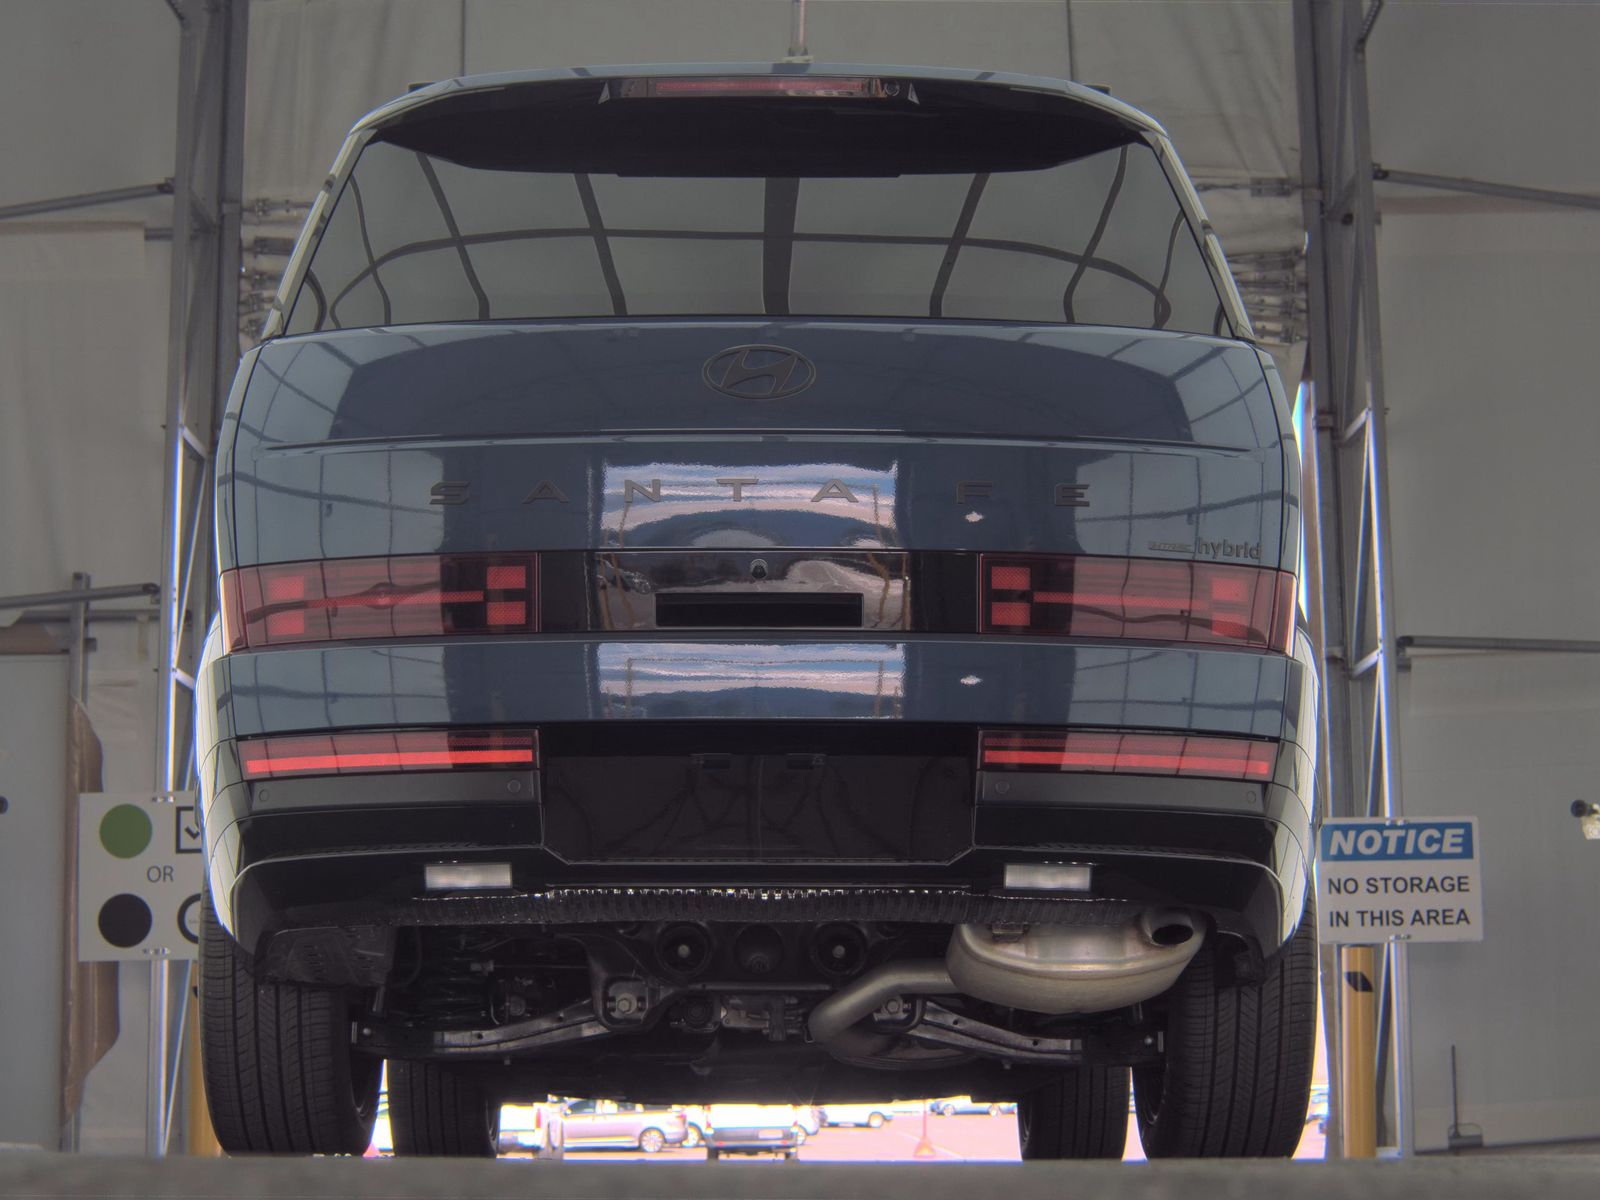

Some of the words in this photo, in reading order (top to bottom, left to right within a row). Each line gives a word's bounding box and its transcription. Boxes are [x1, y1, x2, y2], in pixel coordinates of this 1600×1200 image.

[429, 478, 859, 506] SANTA
[956, 480, 1090, 507] FE
[1197, 538, 1261, 560] hybrid
[1329, 828, 1464, 855] NOTICE
[147, 865, 174, 883] OR
[1328, 878, 1358, 894] NO
[1366, 876, 1470, 893] STORAGE
[1330, 911, 1348, 927] IN
[1356, 910, 1404, 926] THIS
[1411, 909, 1470, 926] AREA
